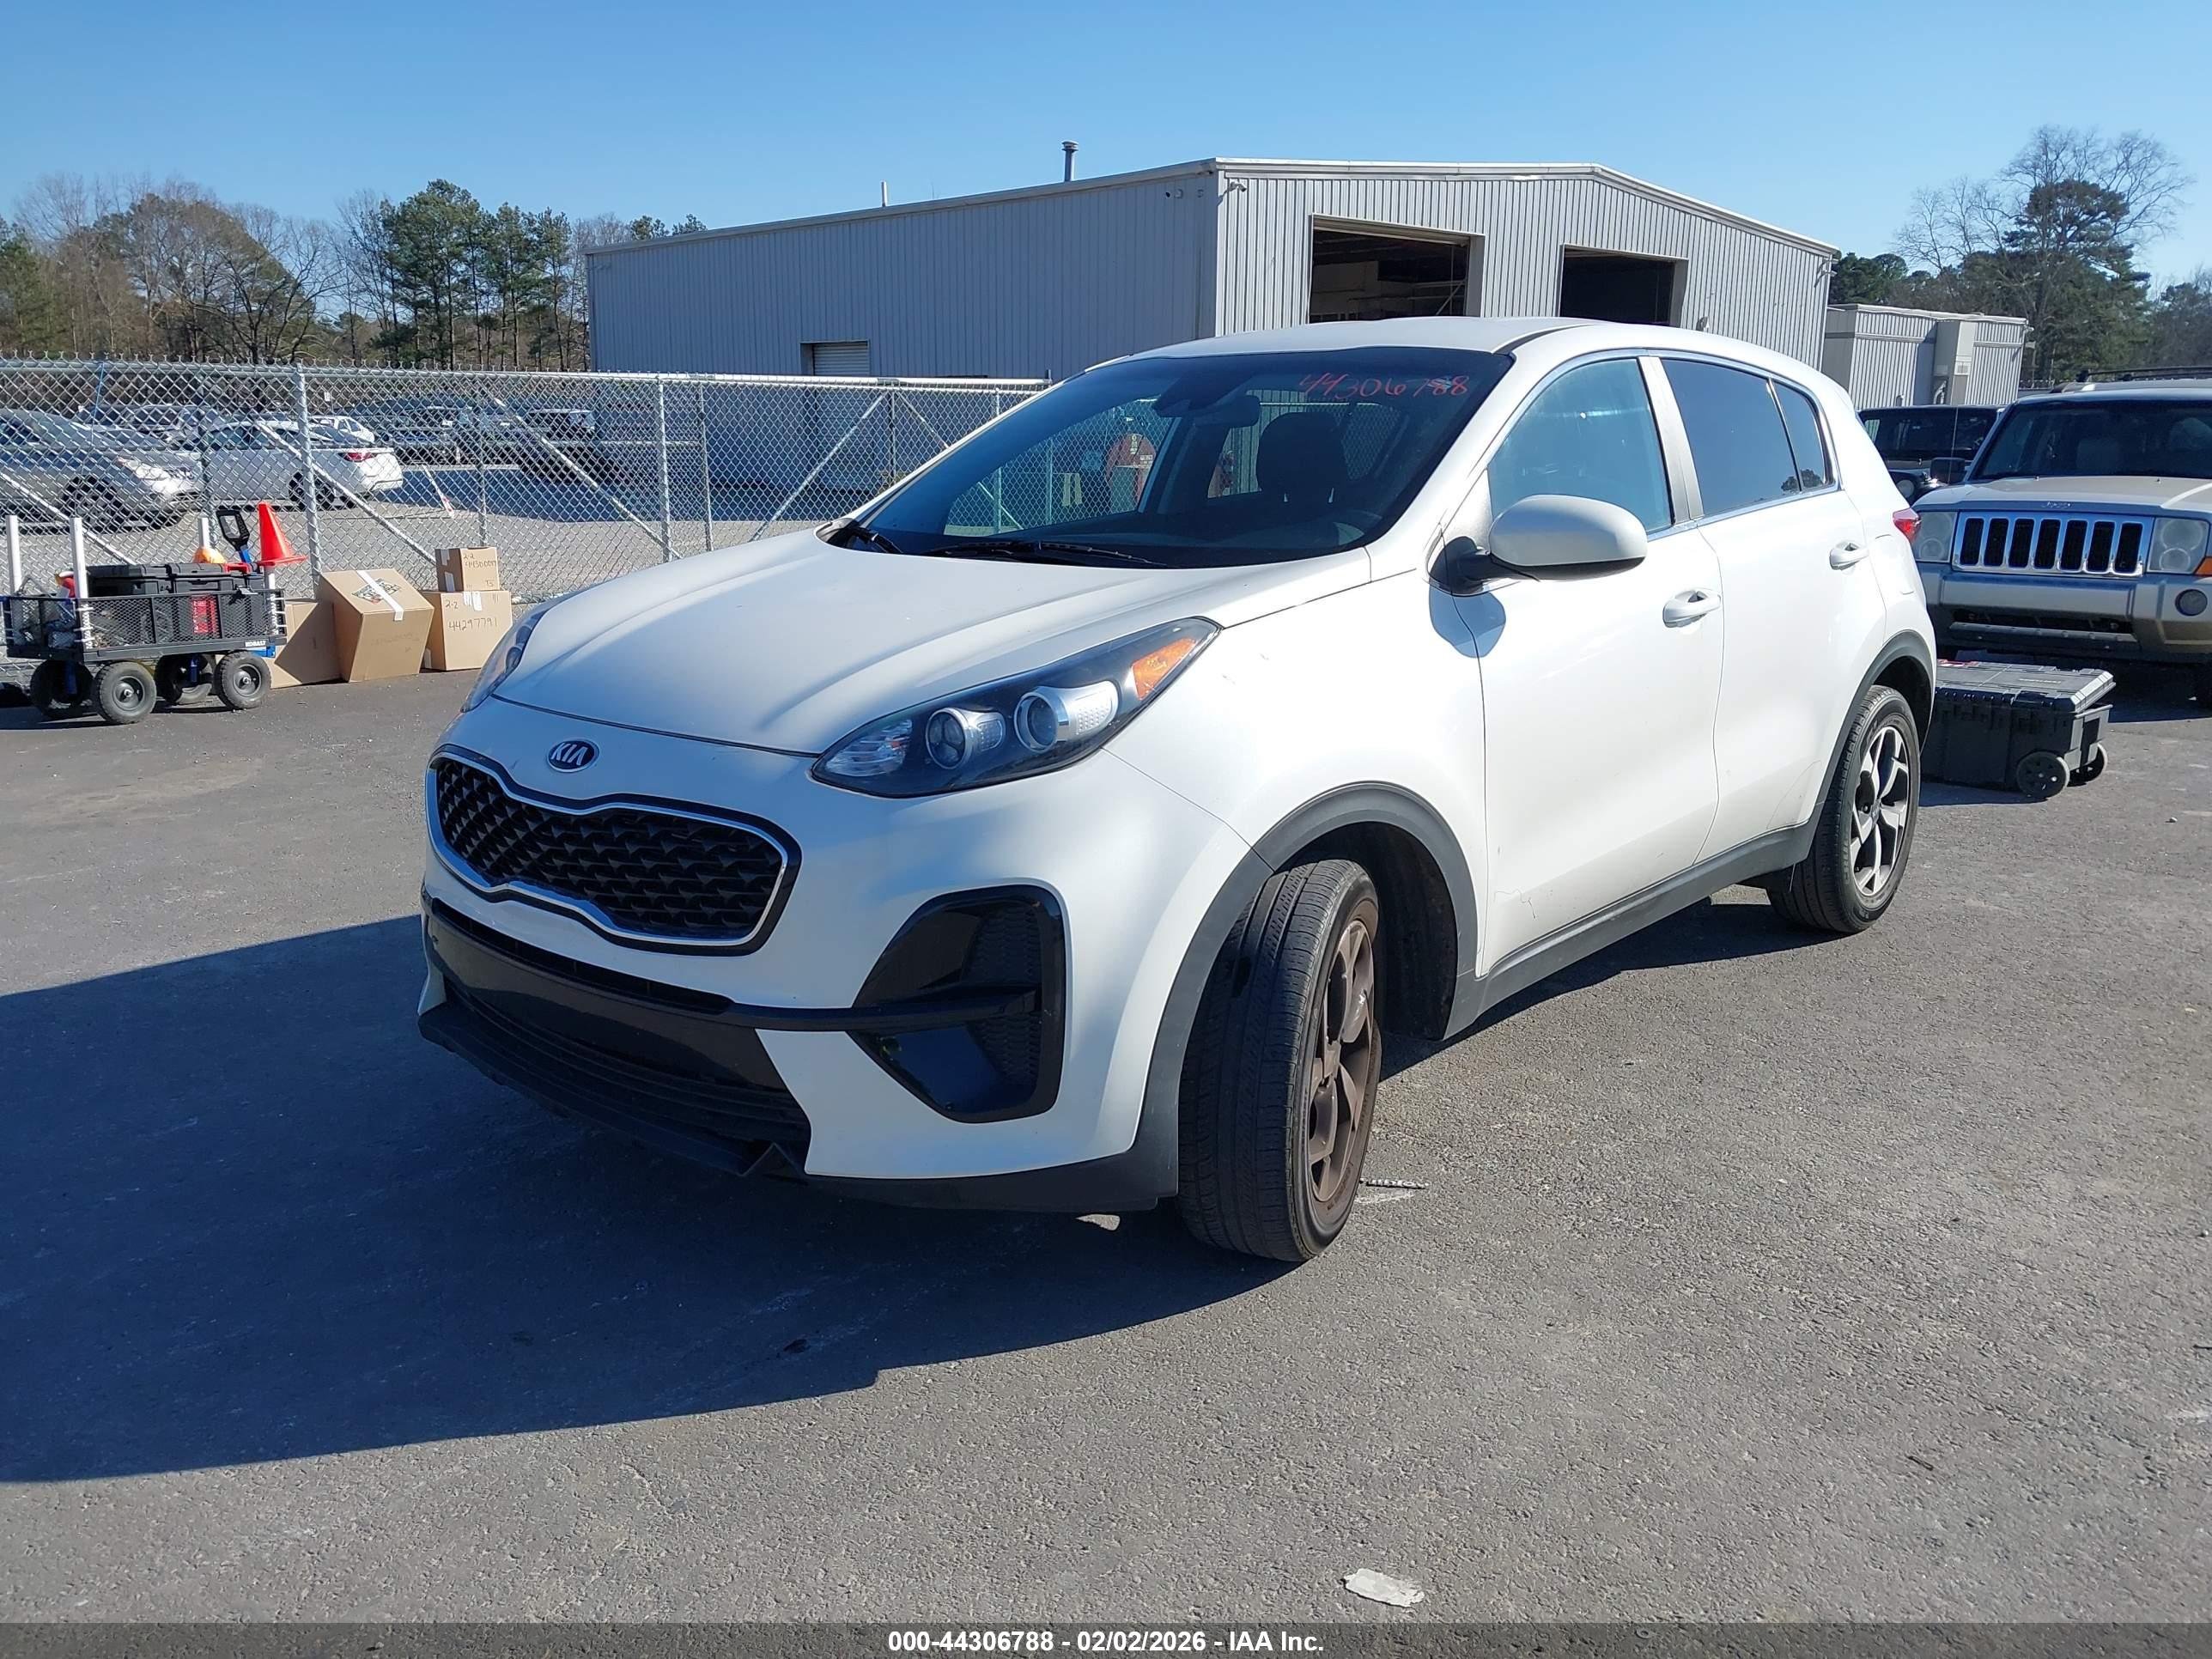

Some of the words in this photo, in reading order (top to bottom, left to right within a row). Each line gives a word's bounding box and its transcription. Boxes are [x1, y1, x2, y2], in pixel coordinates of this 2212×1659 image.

[1299, 372, 1470, 400] 44306788
[448, 617, 498, 632] 44297791
[550, 742, 589, 766] KIA
